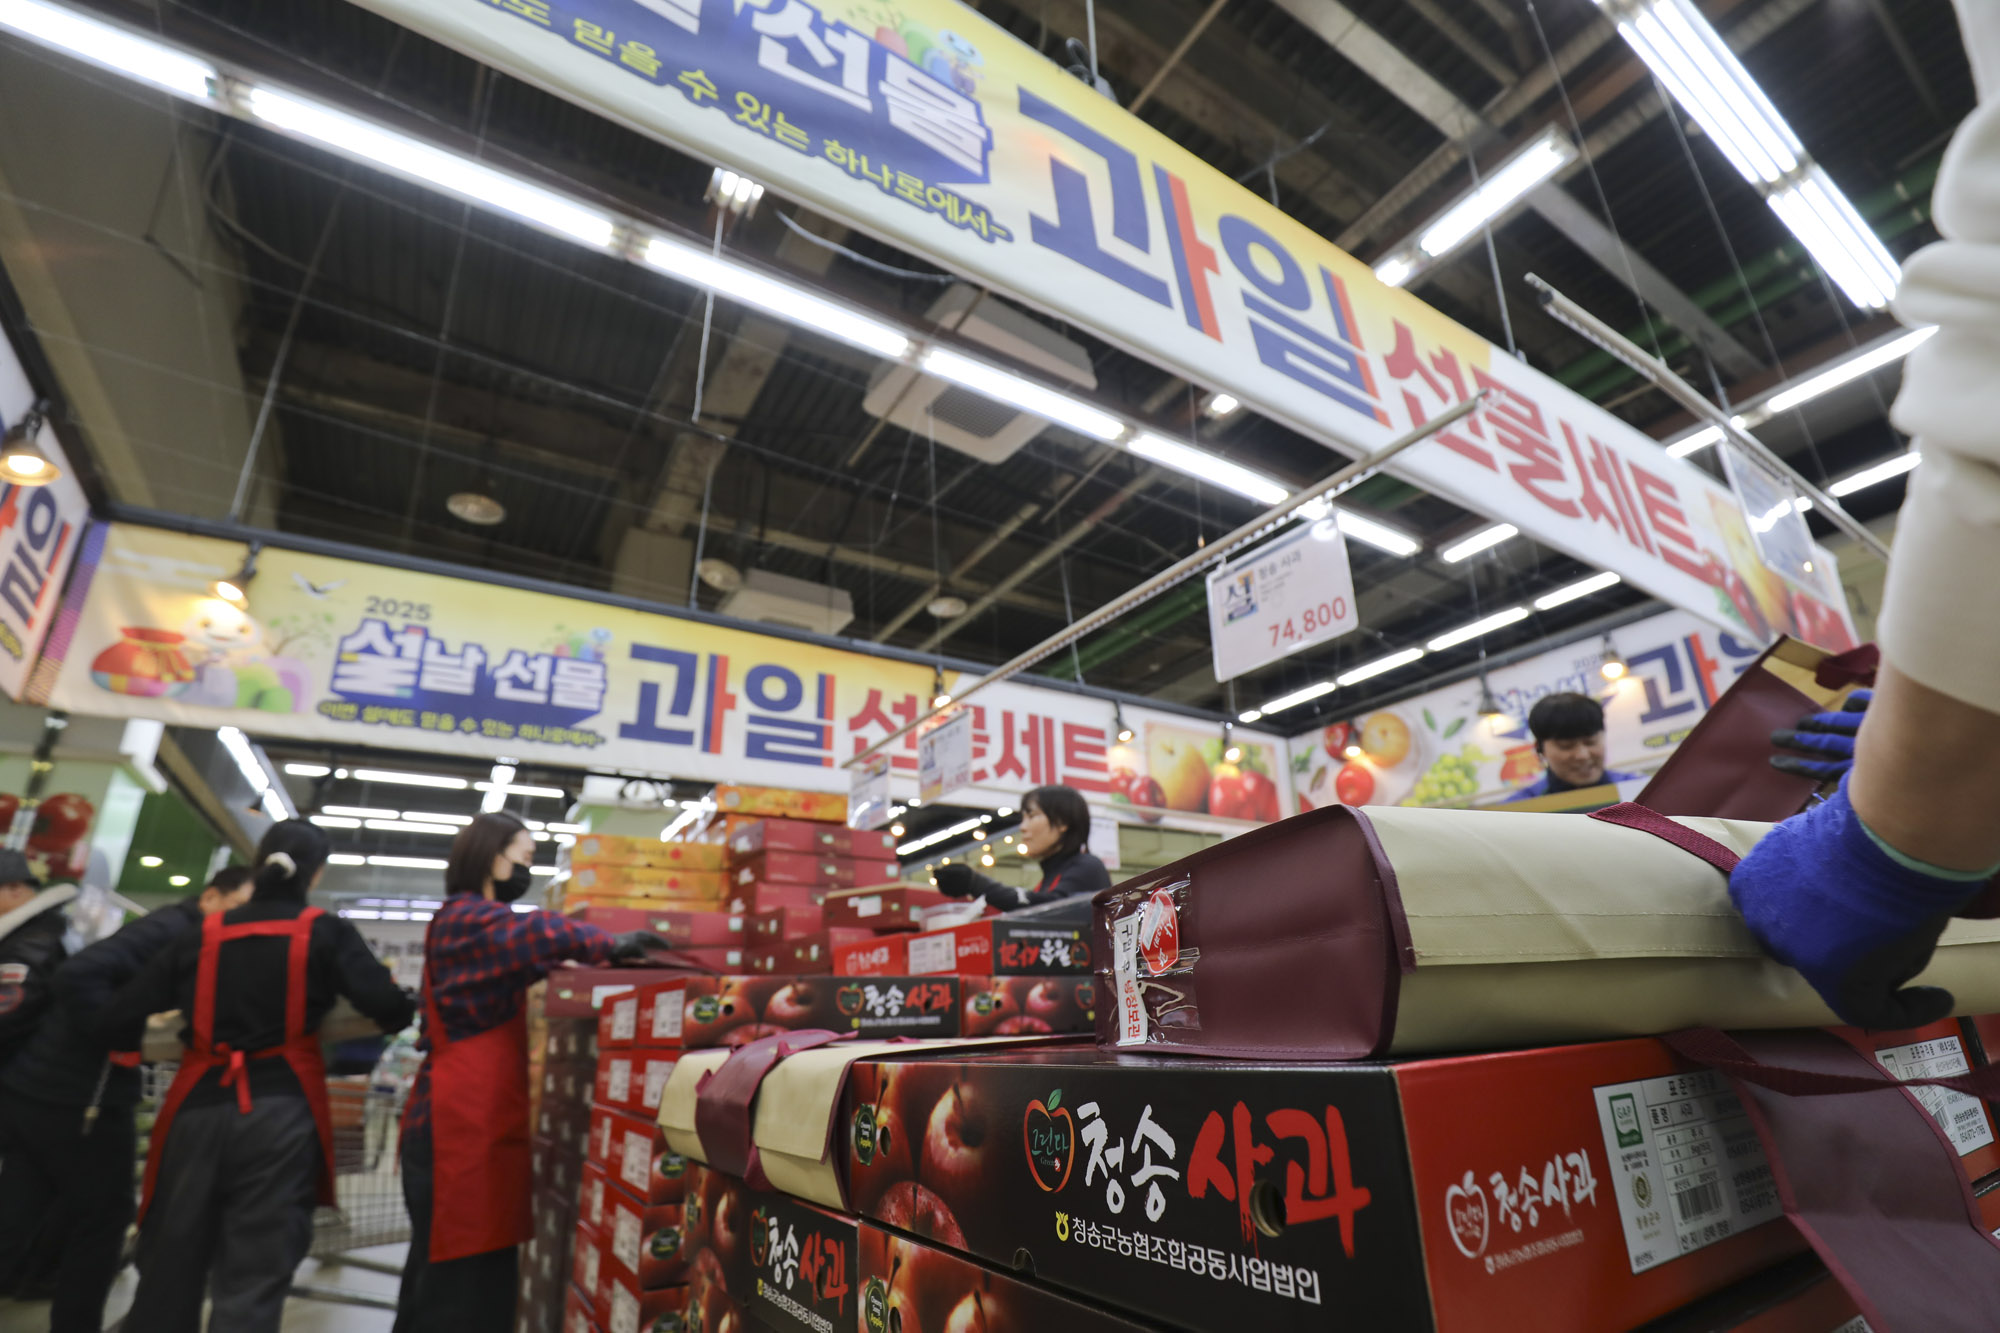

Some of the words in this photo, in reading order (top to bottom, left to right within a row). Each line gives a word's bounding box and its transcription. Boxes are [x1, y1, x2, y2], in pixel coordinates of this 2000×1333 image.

[573, 17, 663, 79] 믿을
[677, 69, 720, 100] 수
[735, 91, 811, 151] 있는
[0, 484, 71, 630] 일
[364, 596, 431, 621] 2025
[1268, 597, 1346, 647] 74,800
[332, 619, 485, 698] 설날
[494, 650, 605, 711] 선물
[1124, 979, 1141, 1039] 냉장보관
[1072, 1216, 1322, 1305] 청송군농협조합공동사업법인
